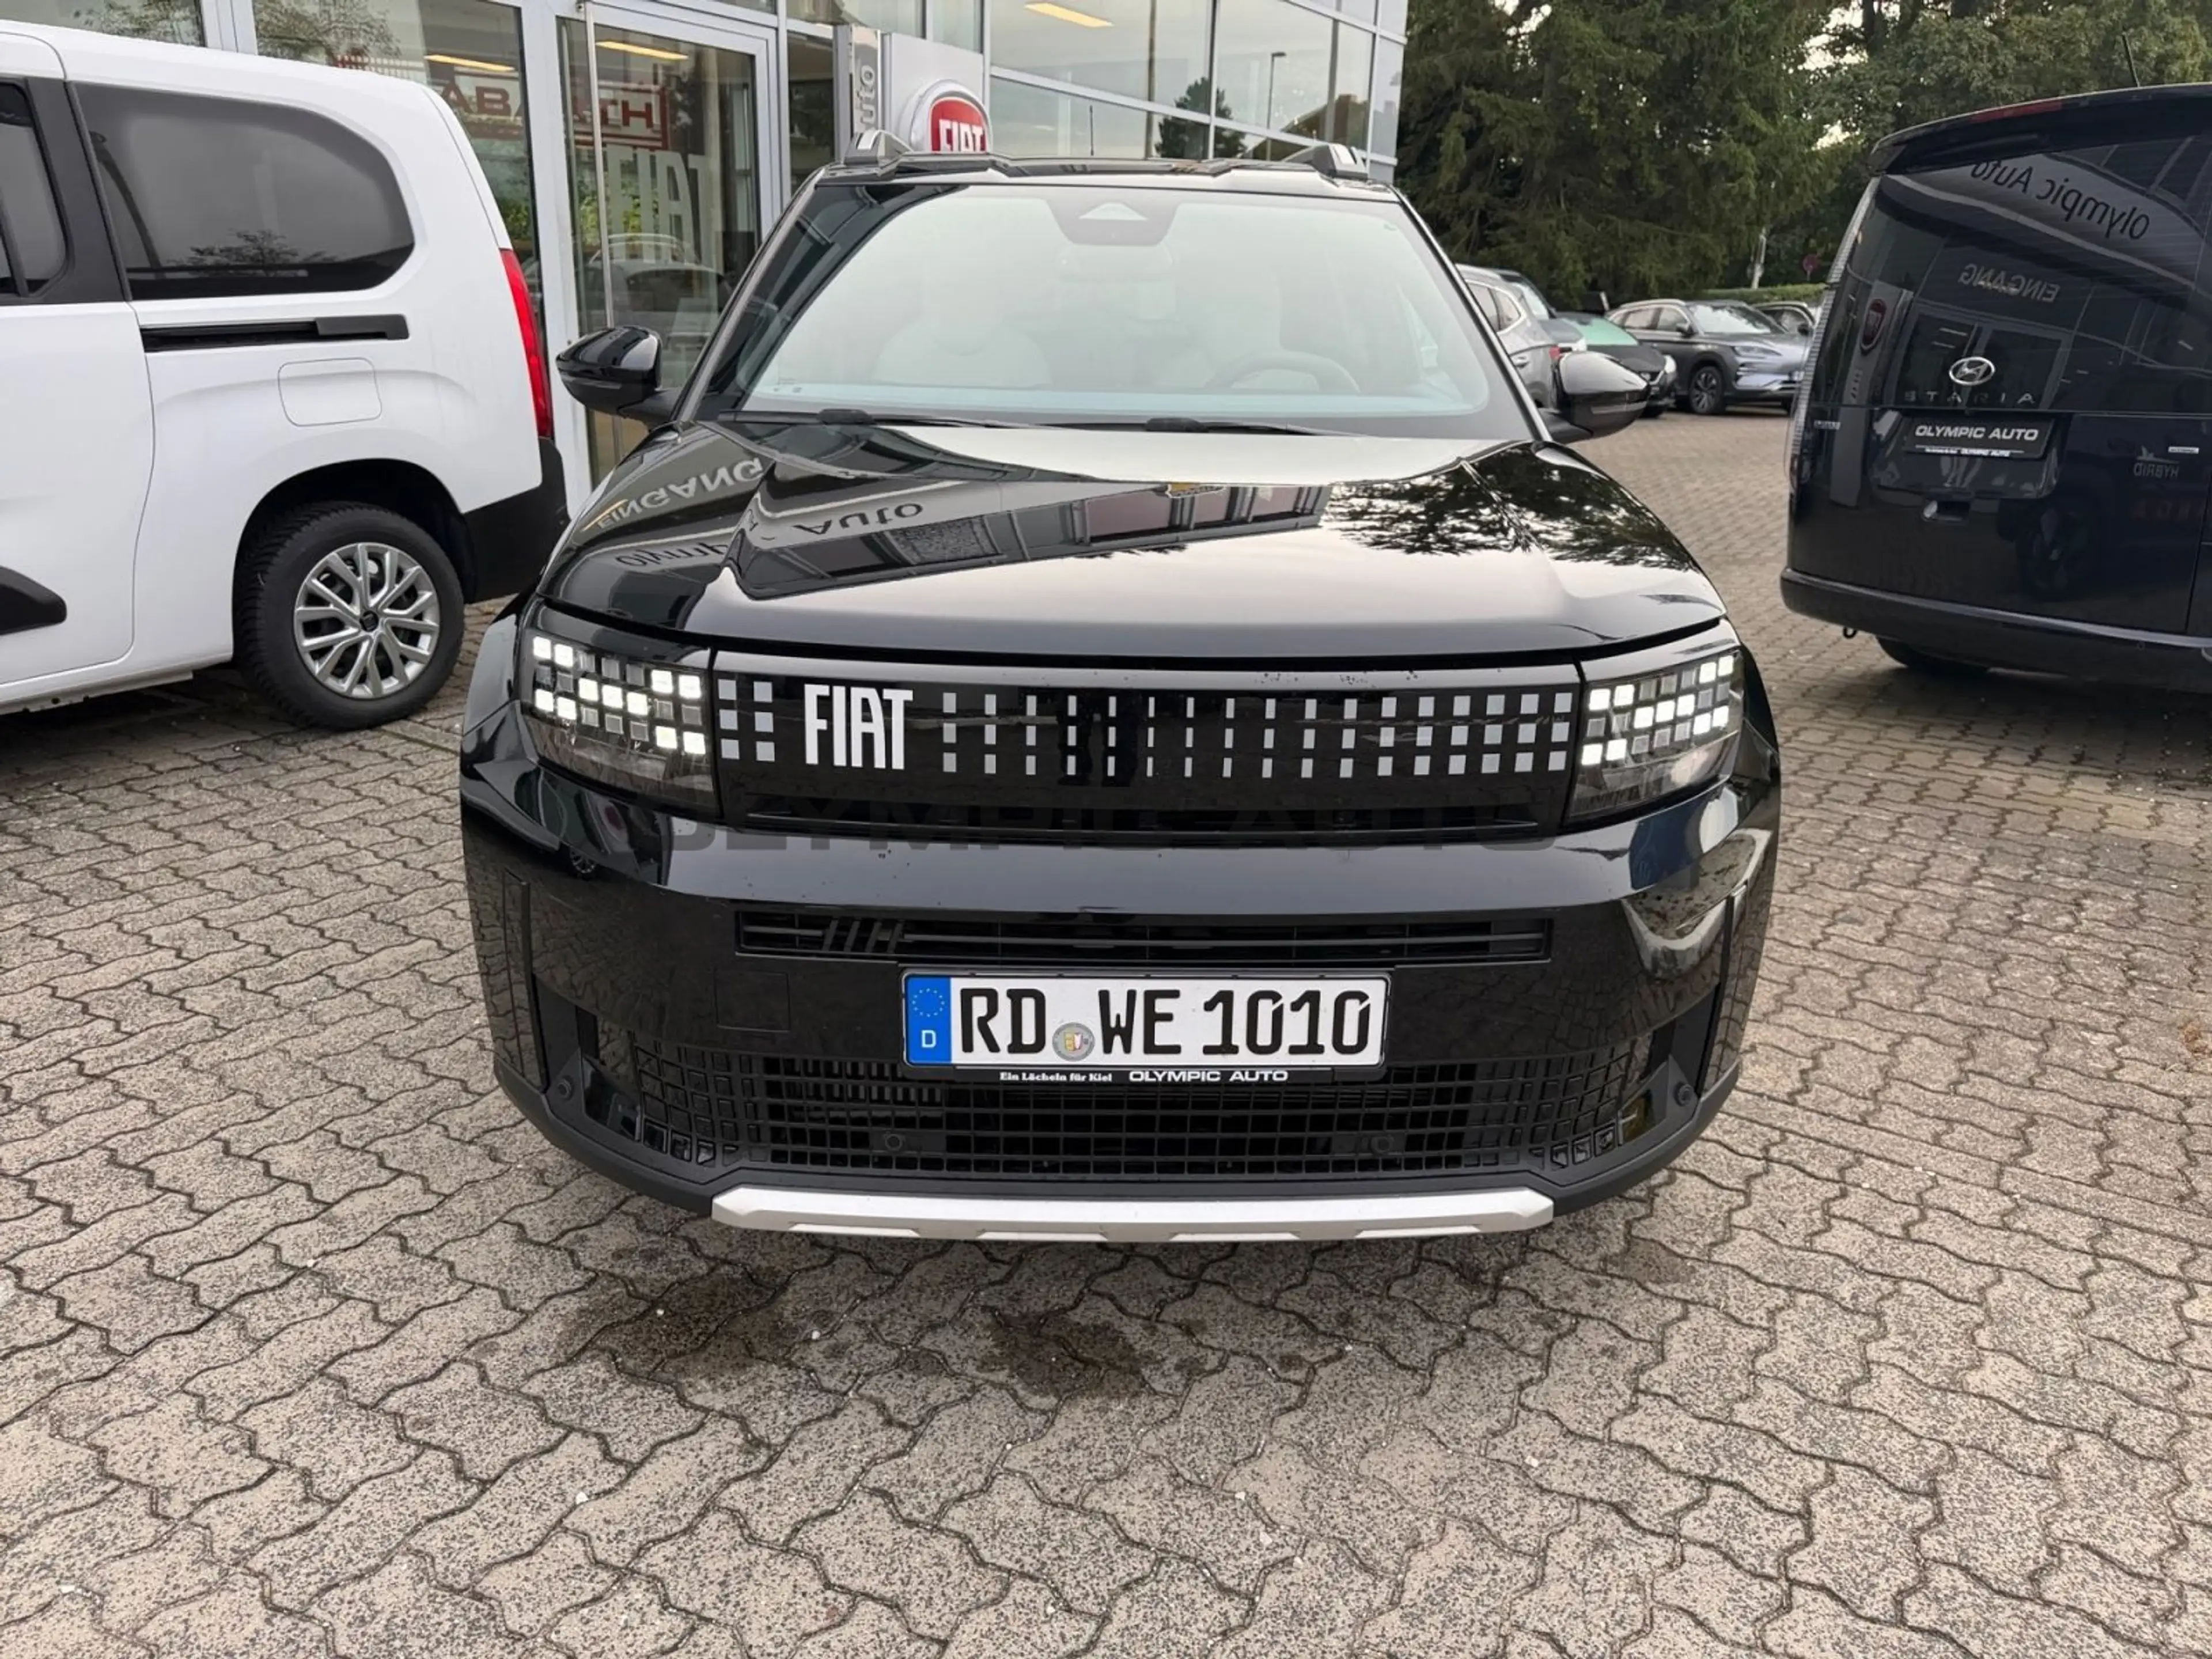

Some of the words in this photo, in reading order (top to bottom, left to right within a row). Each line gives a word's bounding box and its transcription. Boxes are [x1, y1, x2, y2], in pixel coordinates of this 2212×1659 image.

[1904, 391, 2035, 404] STARIA
[1915, 426, 1986, 438] OLYMPIC
[1988, 427, 2039, 441] AUTO
[804, 684, 913, 770] FIAT
[960, 988, 1046, 1054] RD
[1098, 989, 1181, 1055] WE
[1203, 989, 1371, 1055] 1010
[922, 1029, 937, 1048] D
[999, 1071, 1020, 1081] Ein
[1069, 1073, 1086, 1082] für
[1089, 1073, 1112, 1082] Kiel
[1128, 1070, 1221, 1082] OLYMPIC
[1229, 1070, 1289, 1082] AUTO
